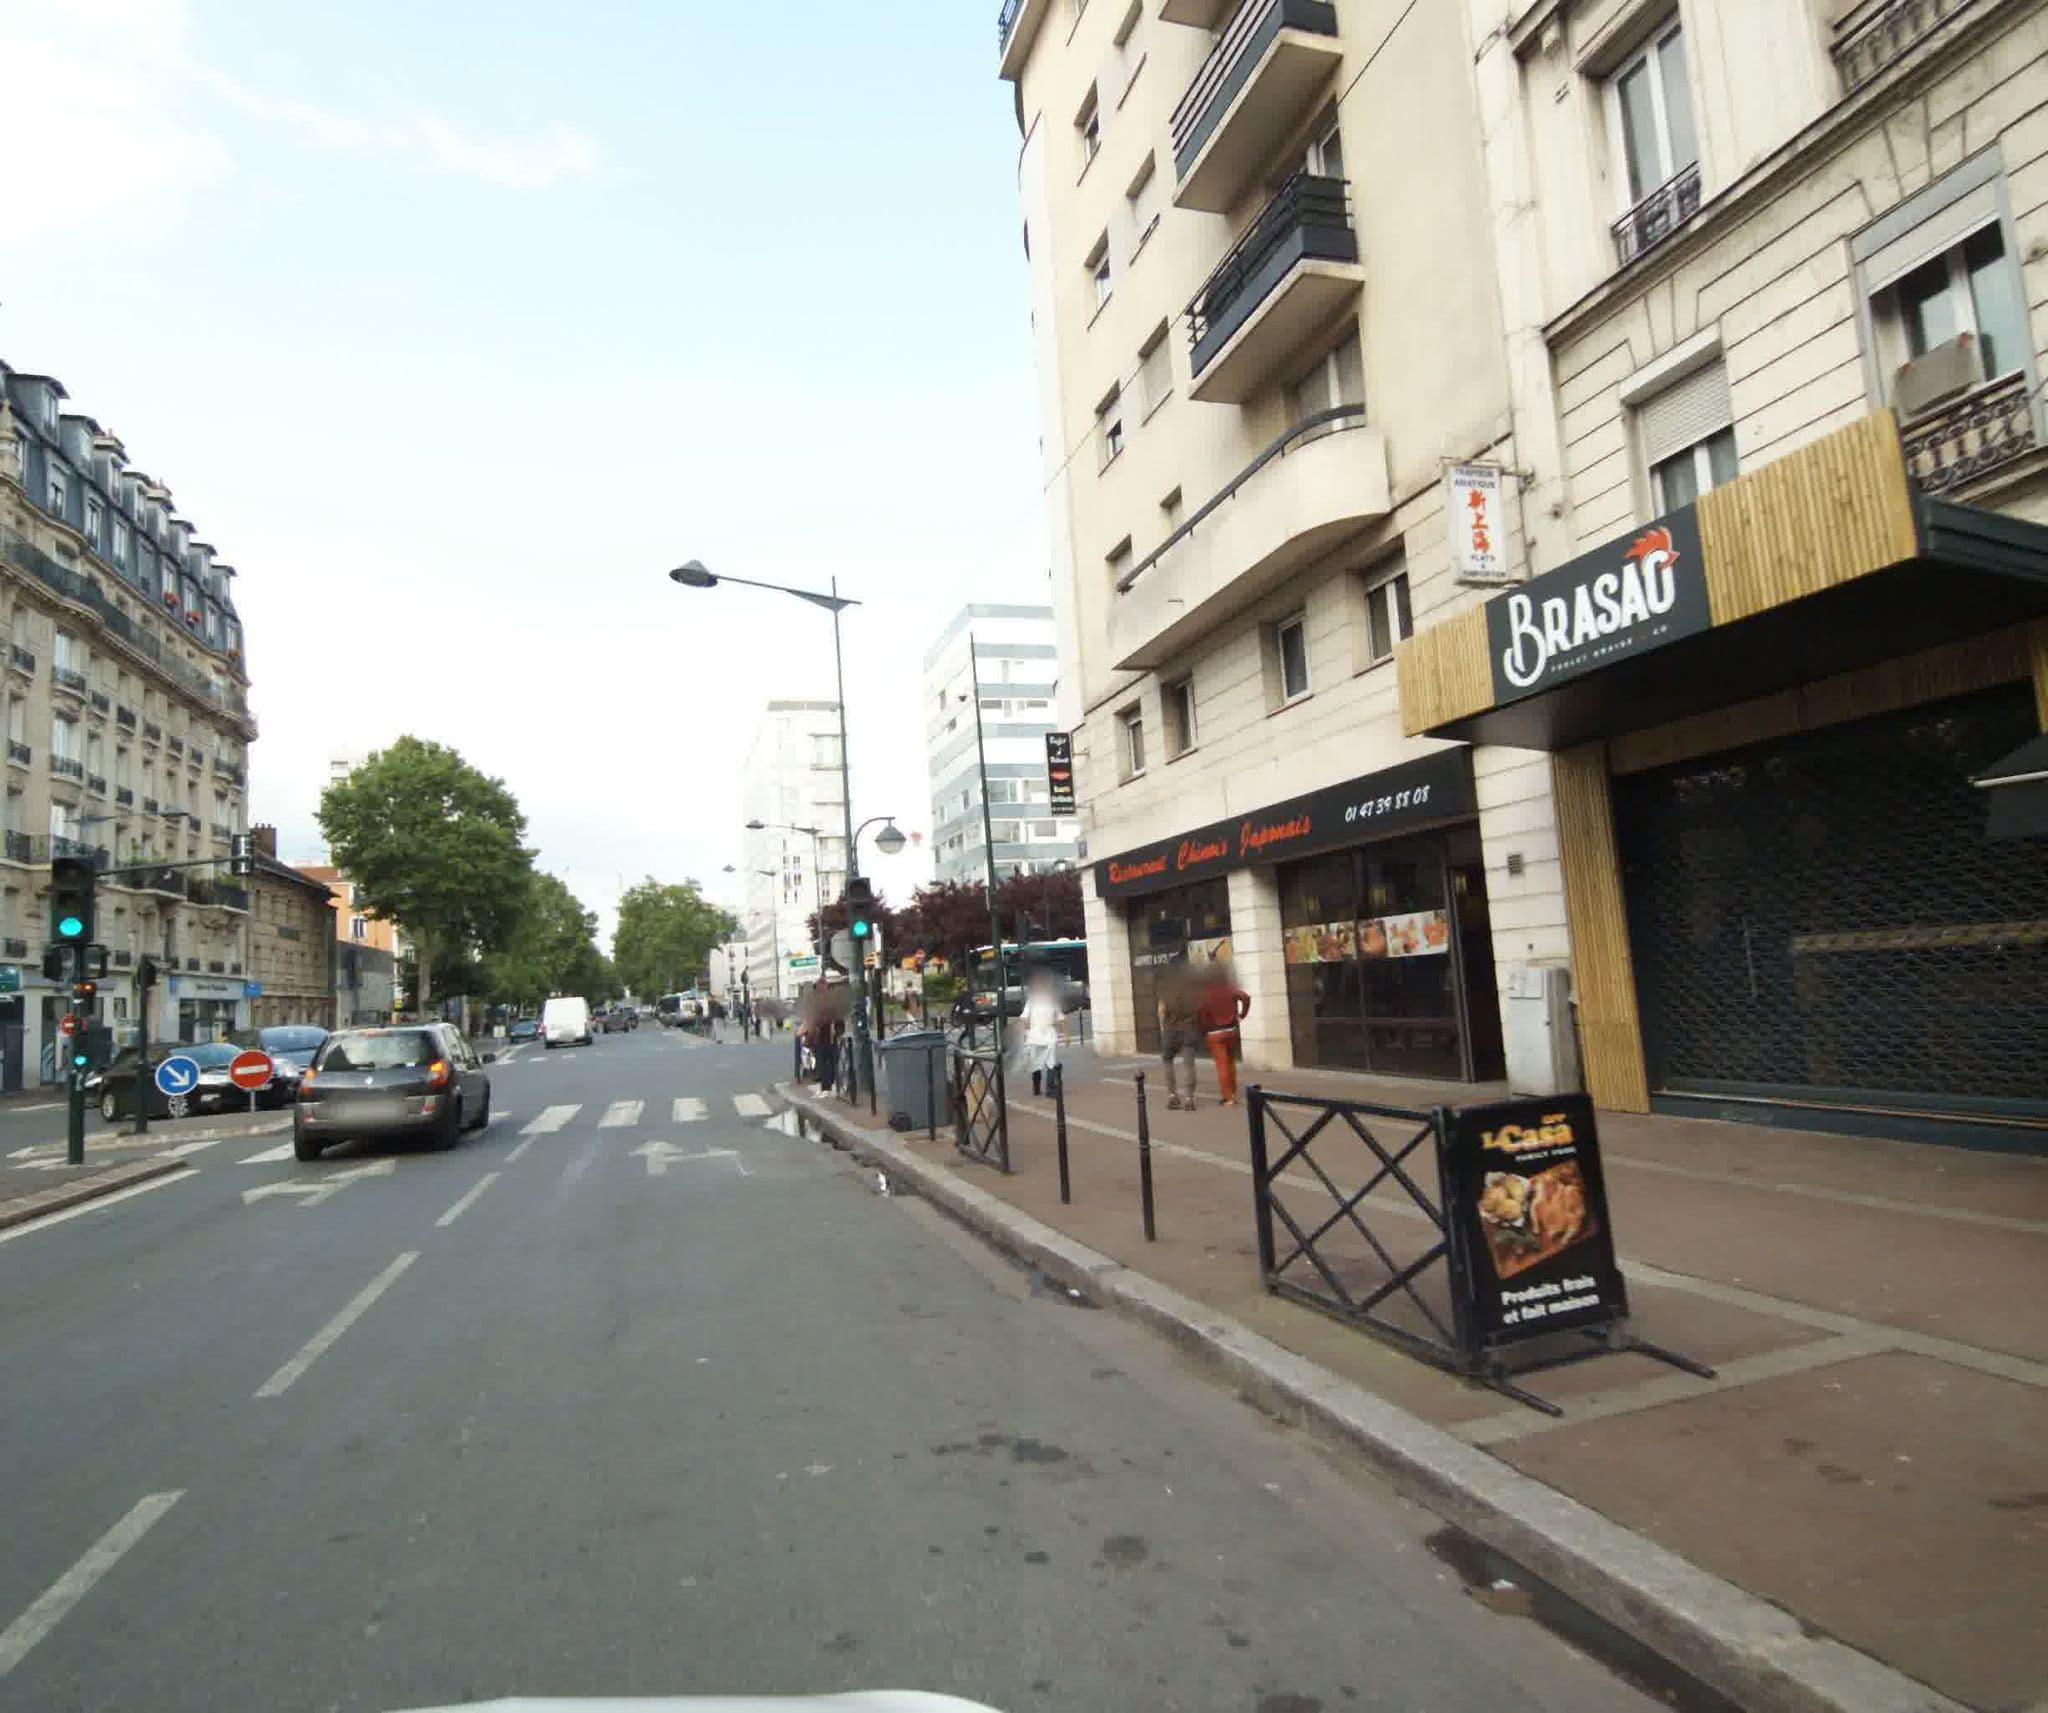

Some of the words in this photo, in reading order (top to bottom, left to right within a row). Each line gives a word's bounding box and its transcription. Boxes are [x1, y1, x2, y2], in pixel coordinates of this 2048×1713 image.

[1503, 549, 1676, 688] BRASAO
[1345, 805, 1357, 822] 01
[1360, 801, 1374, 818] 47
[1376, 796, 1392, 814] 39
[1413, 785, 1430, 805] 08
